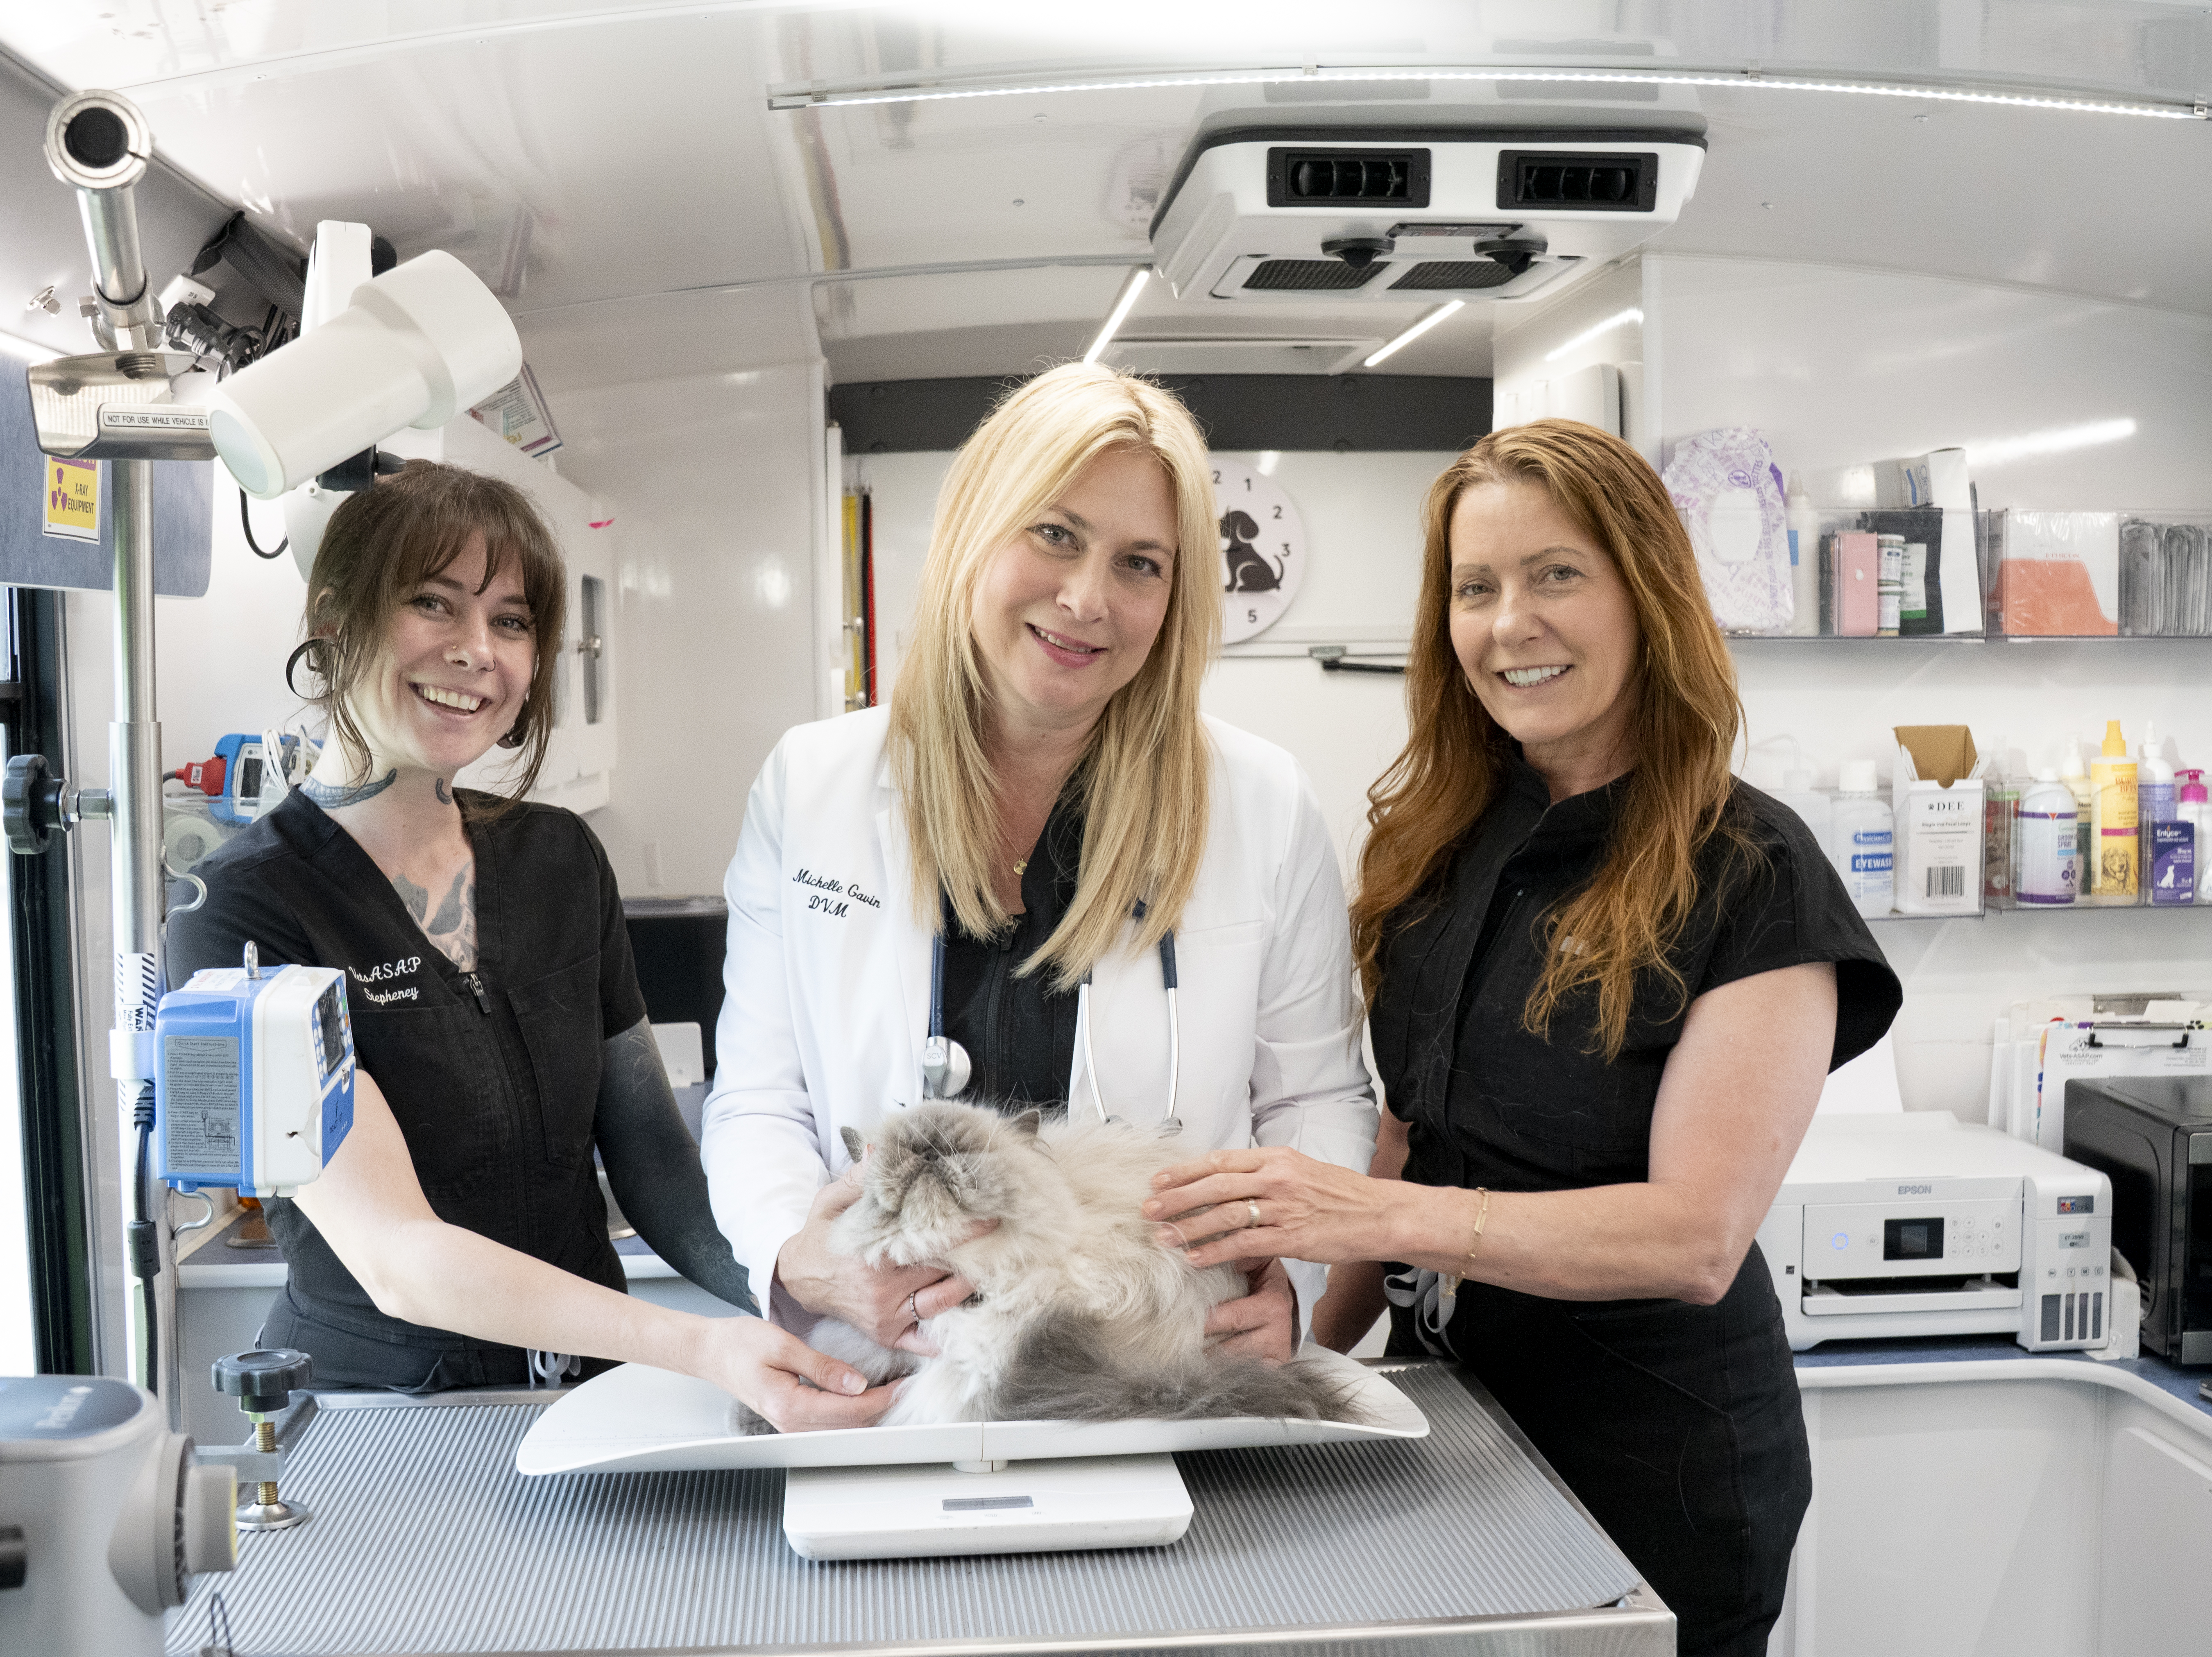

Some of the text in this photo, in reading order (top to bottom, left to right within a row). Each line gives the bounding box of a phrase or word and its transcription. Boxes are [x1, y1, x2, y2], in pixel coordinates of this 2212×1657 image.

[172, 418, 197, 426] VEHICLE
[75, 482, 88, 496] X-RAY
[1244, 478, 1251, 492] 1
[68, 498, 94, 514] EQUIPMENT
[1273, 505, 1282, 519] 2
[1281, 542, 1290, 557] 3
[1248, 609, 1257, 623] 5
[1937, 801, 1964, 811] DEE
[793, 868, 881, 908] Michelle Gavin
[808, 895, 850, 918] DVM
[364, 987, 419, 1006] Stepheney
[1898, 1185, 1932, 1195] EPSON
